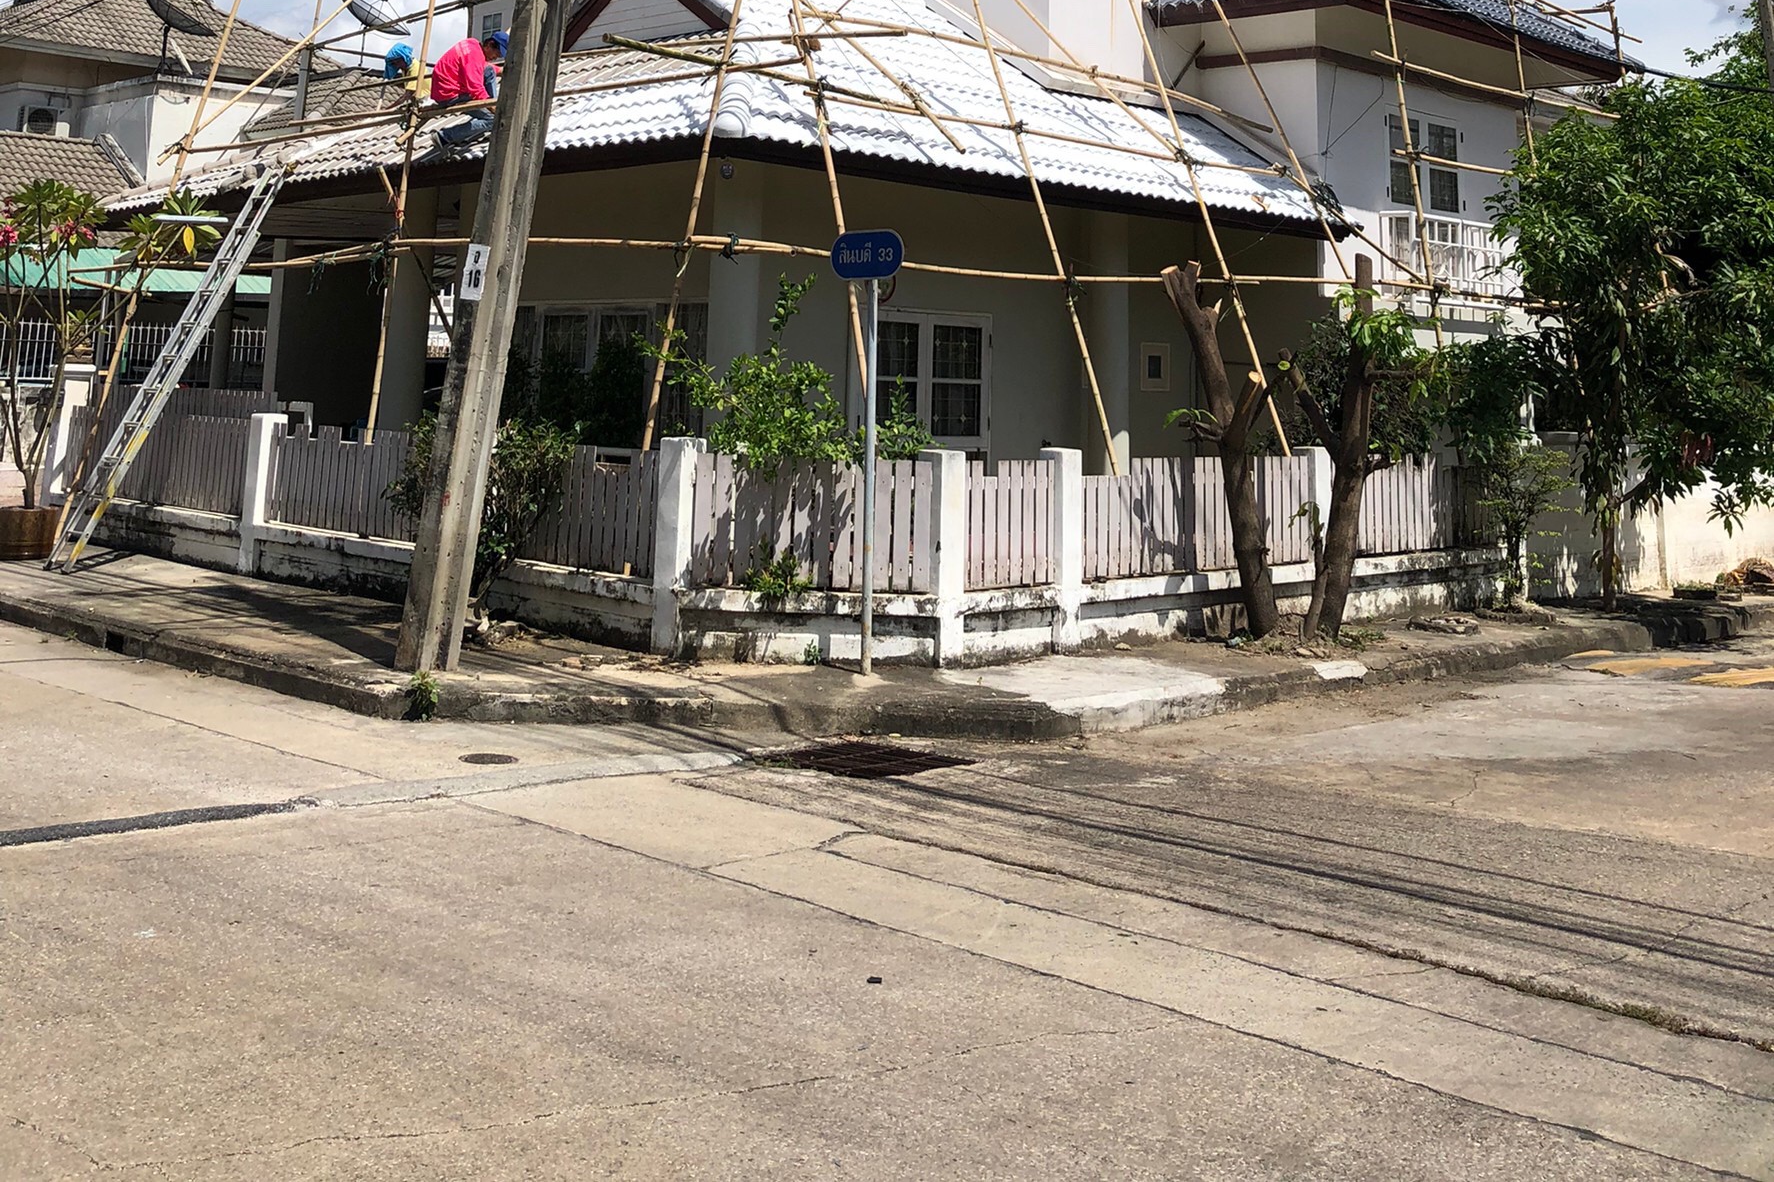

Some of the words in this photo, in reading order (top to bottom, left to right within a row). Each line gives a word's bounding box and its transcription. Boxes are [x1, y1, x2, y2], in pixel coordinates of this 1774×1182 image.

[839, 241, 872, 264] สินบดี
[878, 247, 894, 262] 33
[468, 269, 481, 288] 16
